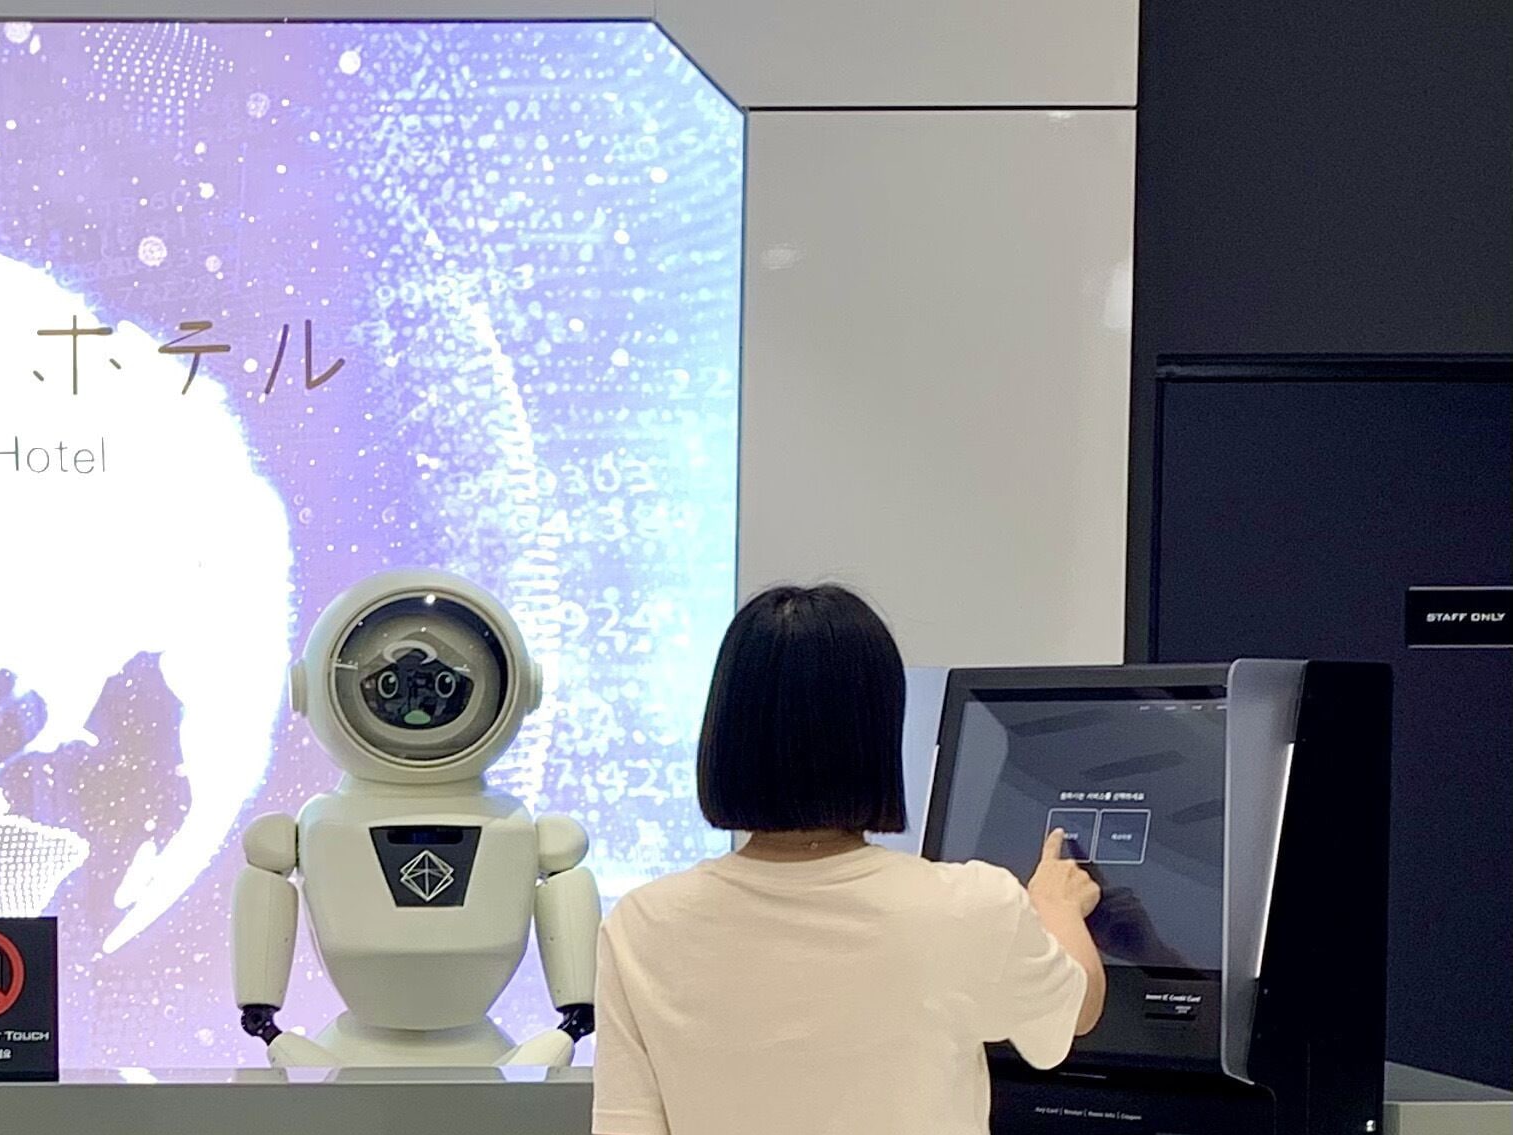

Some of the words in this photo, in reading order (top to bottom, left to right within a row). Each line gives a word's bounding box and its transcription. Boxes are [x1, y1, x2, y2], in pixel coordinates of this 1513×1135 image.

[1426, 612, 1468, 623] STAFF
[1470, 612, 1506, 622] ONLY
[3, 1030, 50, 1041] TOUCH
